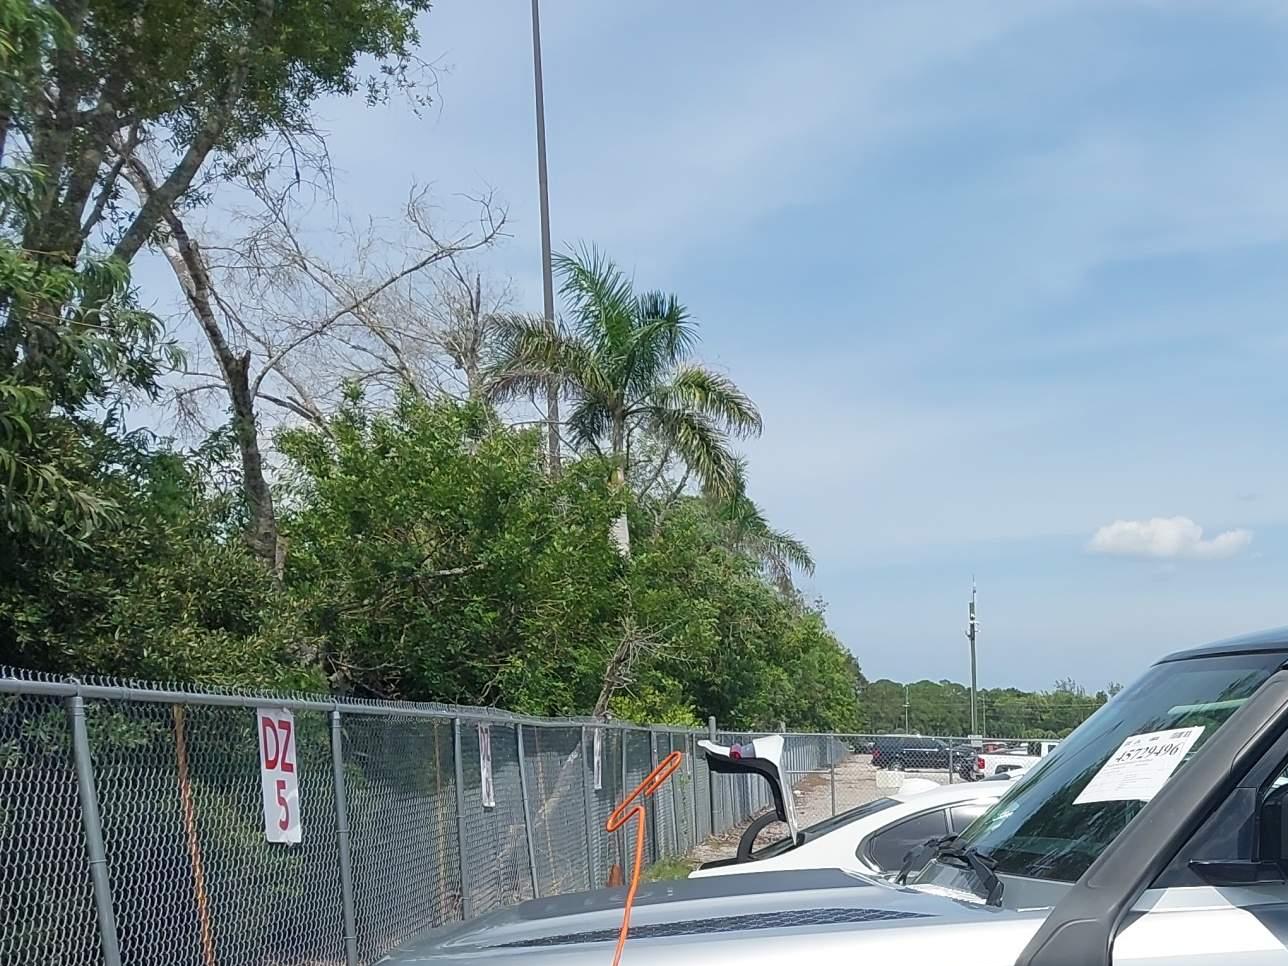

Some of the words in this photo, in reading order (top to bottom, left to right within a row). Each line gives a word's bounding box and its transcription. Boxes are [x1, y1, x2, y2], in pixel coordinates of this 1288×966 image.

[261, 716, 294, 773] DZ
[1116, 743, 1180, 763] 45729496
[276, 779, 290, 831] 5
